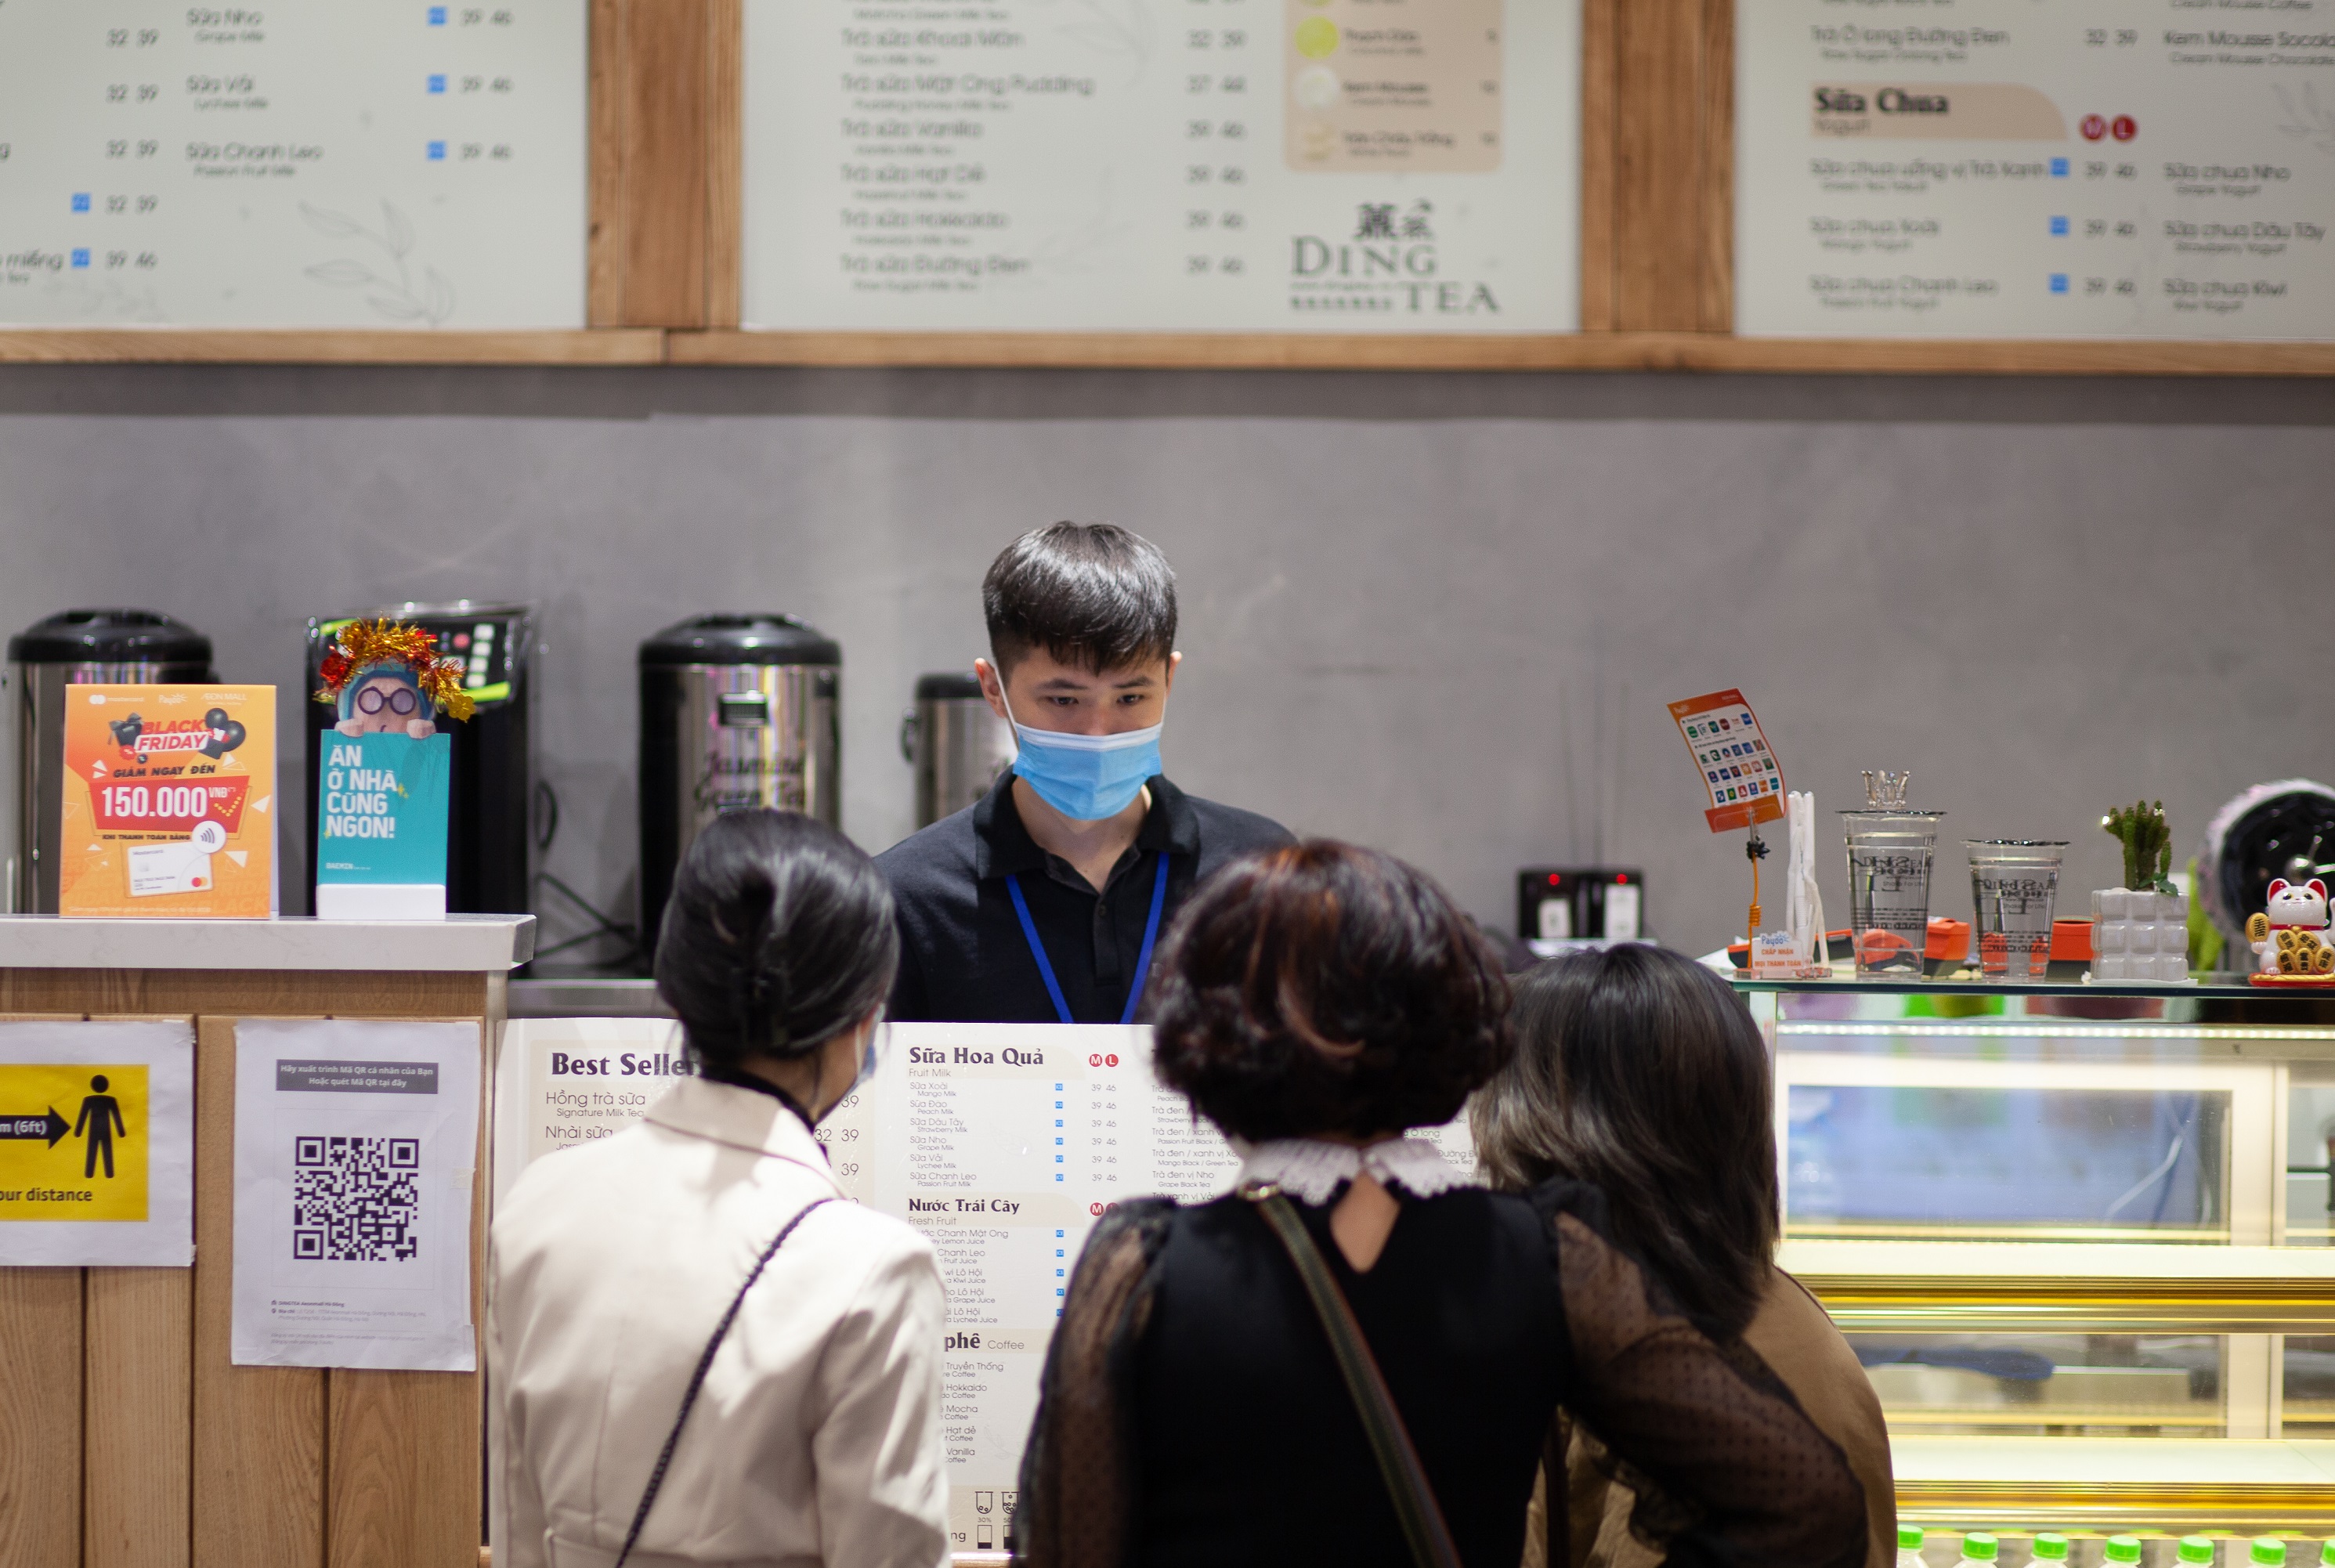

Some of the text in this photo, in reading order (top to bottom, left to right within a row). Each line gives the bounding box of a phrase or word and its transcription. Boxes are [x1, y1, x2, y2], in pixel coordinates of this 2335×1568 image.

[1292, 236, 1437, 277] DING
[1407, 283, 1500, 313] TEA
[159, 692, 187, 705] Payoo
[143, 720, 205, 734] BLACK
[139, 735, 207, 751] FRIDAY
[329, 746, 361, 767] ĂN
[114, 763, 215, 778] GIẢM NGAY ĐẾN
[328, 768, 397, 791] Ở NHÀ
[101, 786, 208, 818] 150.000
[327, 789, 387, 815] CŨNG
[326, 815, 394, 838] NGON!
[1762, 934, 1789, 946] Payoo
[551, 1053, 610, 1075] Best
[910, 1047, 1043, 1067] Sữa Hoa Quả
[909, 1068, 951, 1077] Fruit Milk
[546, 1089, 645, 1109] Hồng trà sữa
[841, 1095, 859, 1108] 39
[556, 1107, 603, 1118] Signature
[606, 1108, 625, 1117] Milk
[14, 1121, 46, 1135] (6ft)
[949, 1118, 963, 1127] Tây
[546, 1125, 613, 1139] Nhài sữa
[815, 1129, 859, 1142] 32 39
[1422, 1129, 1440, 1139] long
[841, 1162, 859, 1176] 39
[0, 1188, 92, 1201] our distance
[909, 1198, 1019, 1214] Nước Trái Cây
[909, 1216, 956, 1225] Fresh Fruit
[970, 1230, 987, 1238] Mật
[989, 1230, 1008, 1239] Ong
[945, 1331, 980, 1352] phê
[988, 1340, 1025, 1349] Coffee
[946, 1361, 1003, 1372] Truyền Thống
[946, 1425, 976, 1436] Hạt dẻ
